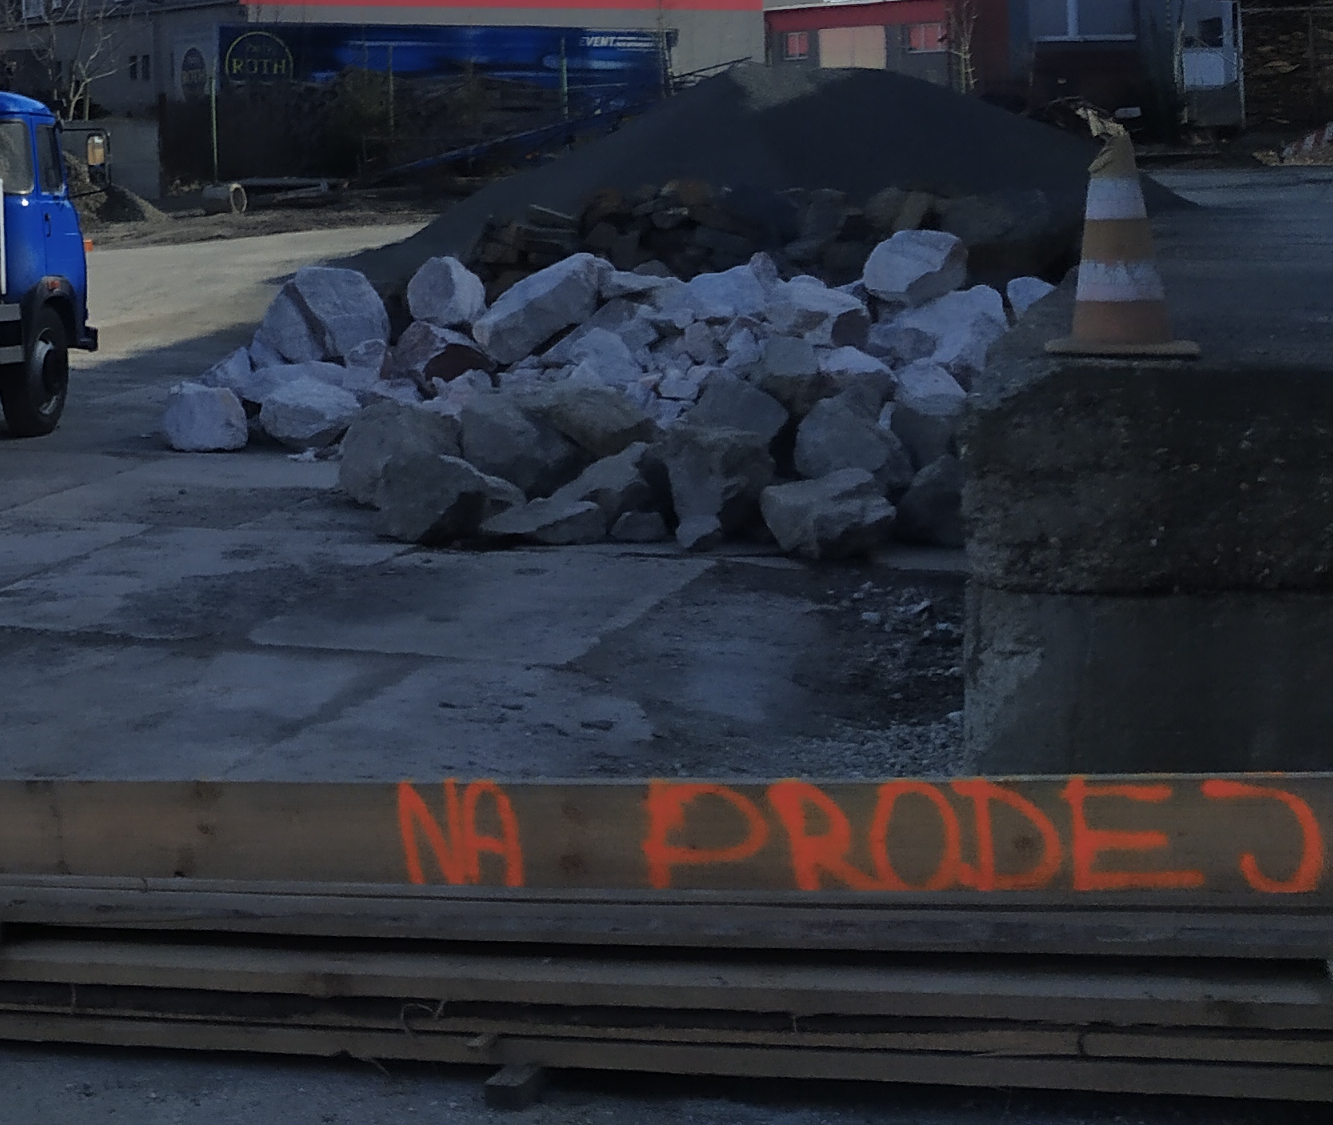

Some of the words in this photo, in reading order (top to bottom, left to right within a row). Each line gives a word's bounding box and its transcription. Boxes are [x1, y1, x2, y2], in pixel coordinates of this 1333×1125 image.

[579, 36, 616, 47] EVENT
[232, 58, 286, 75] ROTH
[397, 778, 526, 888] NA
[642, 775, 1326, 894] PRODEJ
